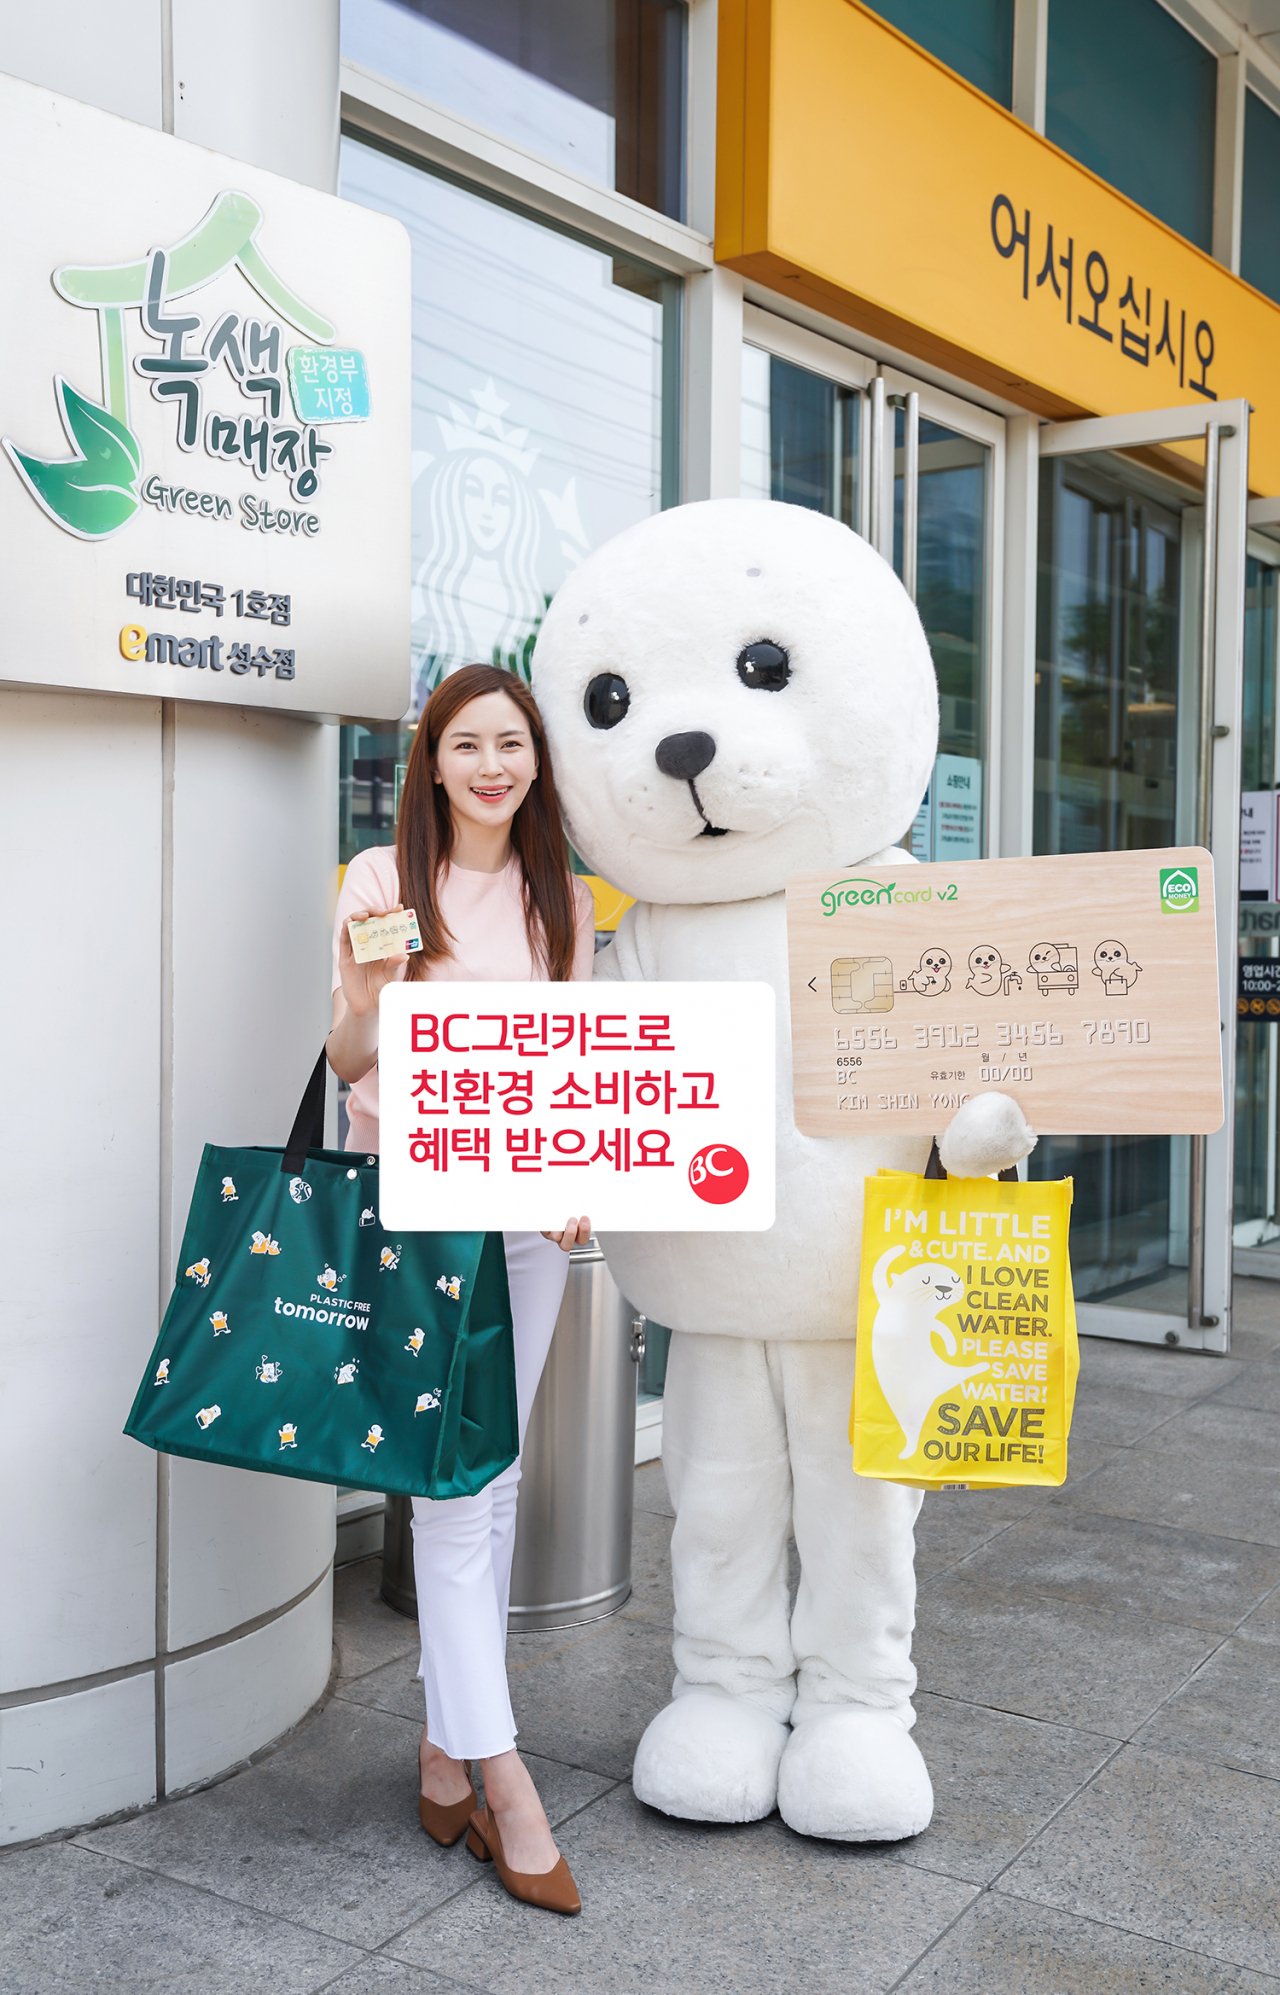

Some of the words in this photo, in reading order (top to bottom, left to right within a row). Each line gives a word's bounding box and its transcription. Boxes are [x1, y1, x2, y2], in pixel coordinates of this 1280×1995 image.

[991, 193, 1217, 401] 어서오십시오
[139, 248, 282, 446] 녹색
[299, 353, 359, 385] 환경부
[315, 387, 352, 416] 지정
[210, 416, 333, 497] 매장
[145, 475, 233, 518] Green
[246, 496, 321, 535] Store
[126, 572, 227, 617] 대한민국
[231, 589, 291, 626] 1호점
[119, 624, 224, 671] emart
[227, 642, 295, 679] 성수점
[937, 884, 958, 901] v2
[1168, 883, 1191, 893] ECO
[411, 1012, 676, 1056] BC그린카드로
[834, 1026, 898, 1050] 6556
[913, 1023, 979, 1048] 3912
[995, 1021, 1063, 1046] 3456
[1081, 1019, 1150, 1044] 7890
[836, 1057, 863, 1066] 6556
[981, 1052, 990, 1063] 월
[1018, 1052, 1028, 1062] 년
[836, 1069, 858, 1085] BC
[930, 1071, 966, 1081] 유효기한
[410, 1069, 534, 1116] 친환경
[549, 1069, 720, 1115] 소비하고
[837, 1094, 869, 1110] KIM
[877, 1093, 919, 1109] SHIN
[408, 1127, 490, 1172] 혜택
[505, 1127, 675, 1172] 받으세요
[690, 1147, 734, 1185] BC
[884, 1208, 927, 1234] I'M
[939, 1211, 1051, 1239] LITTLE
[996, 1243, 1050, 1264] AND
[967, 1265, 972, 1285] I
[981, 1266, 1049, 1288] LOVE
[274, 1296, 370, 1331] tomorrow
[310, 1293, 353, 1310] PLASTIC
[353, 1301, 372, 1312] FREE
[966, 1290, 1048, 1313] CLEAN
[956, 1314, 1053, 1338] WATER.
[962, 1338, 1048, 1360] PLEASE
[991, 1363, 1047, 1381] SAVE
[960, 1382, 1047, 1403] WATER!
[936, 1403, 1045, 1439] SAVE
[923, 1439, 980, 1463] OUR
[986, 1442, 1045, 1465] LIFE!
